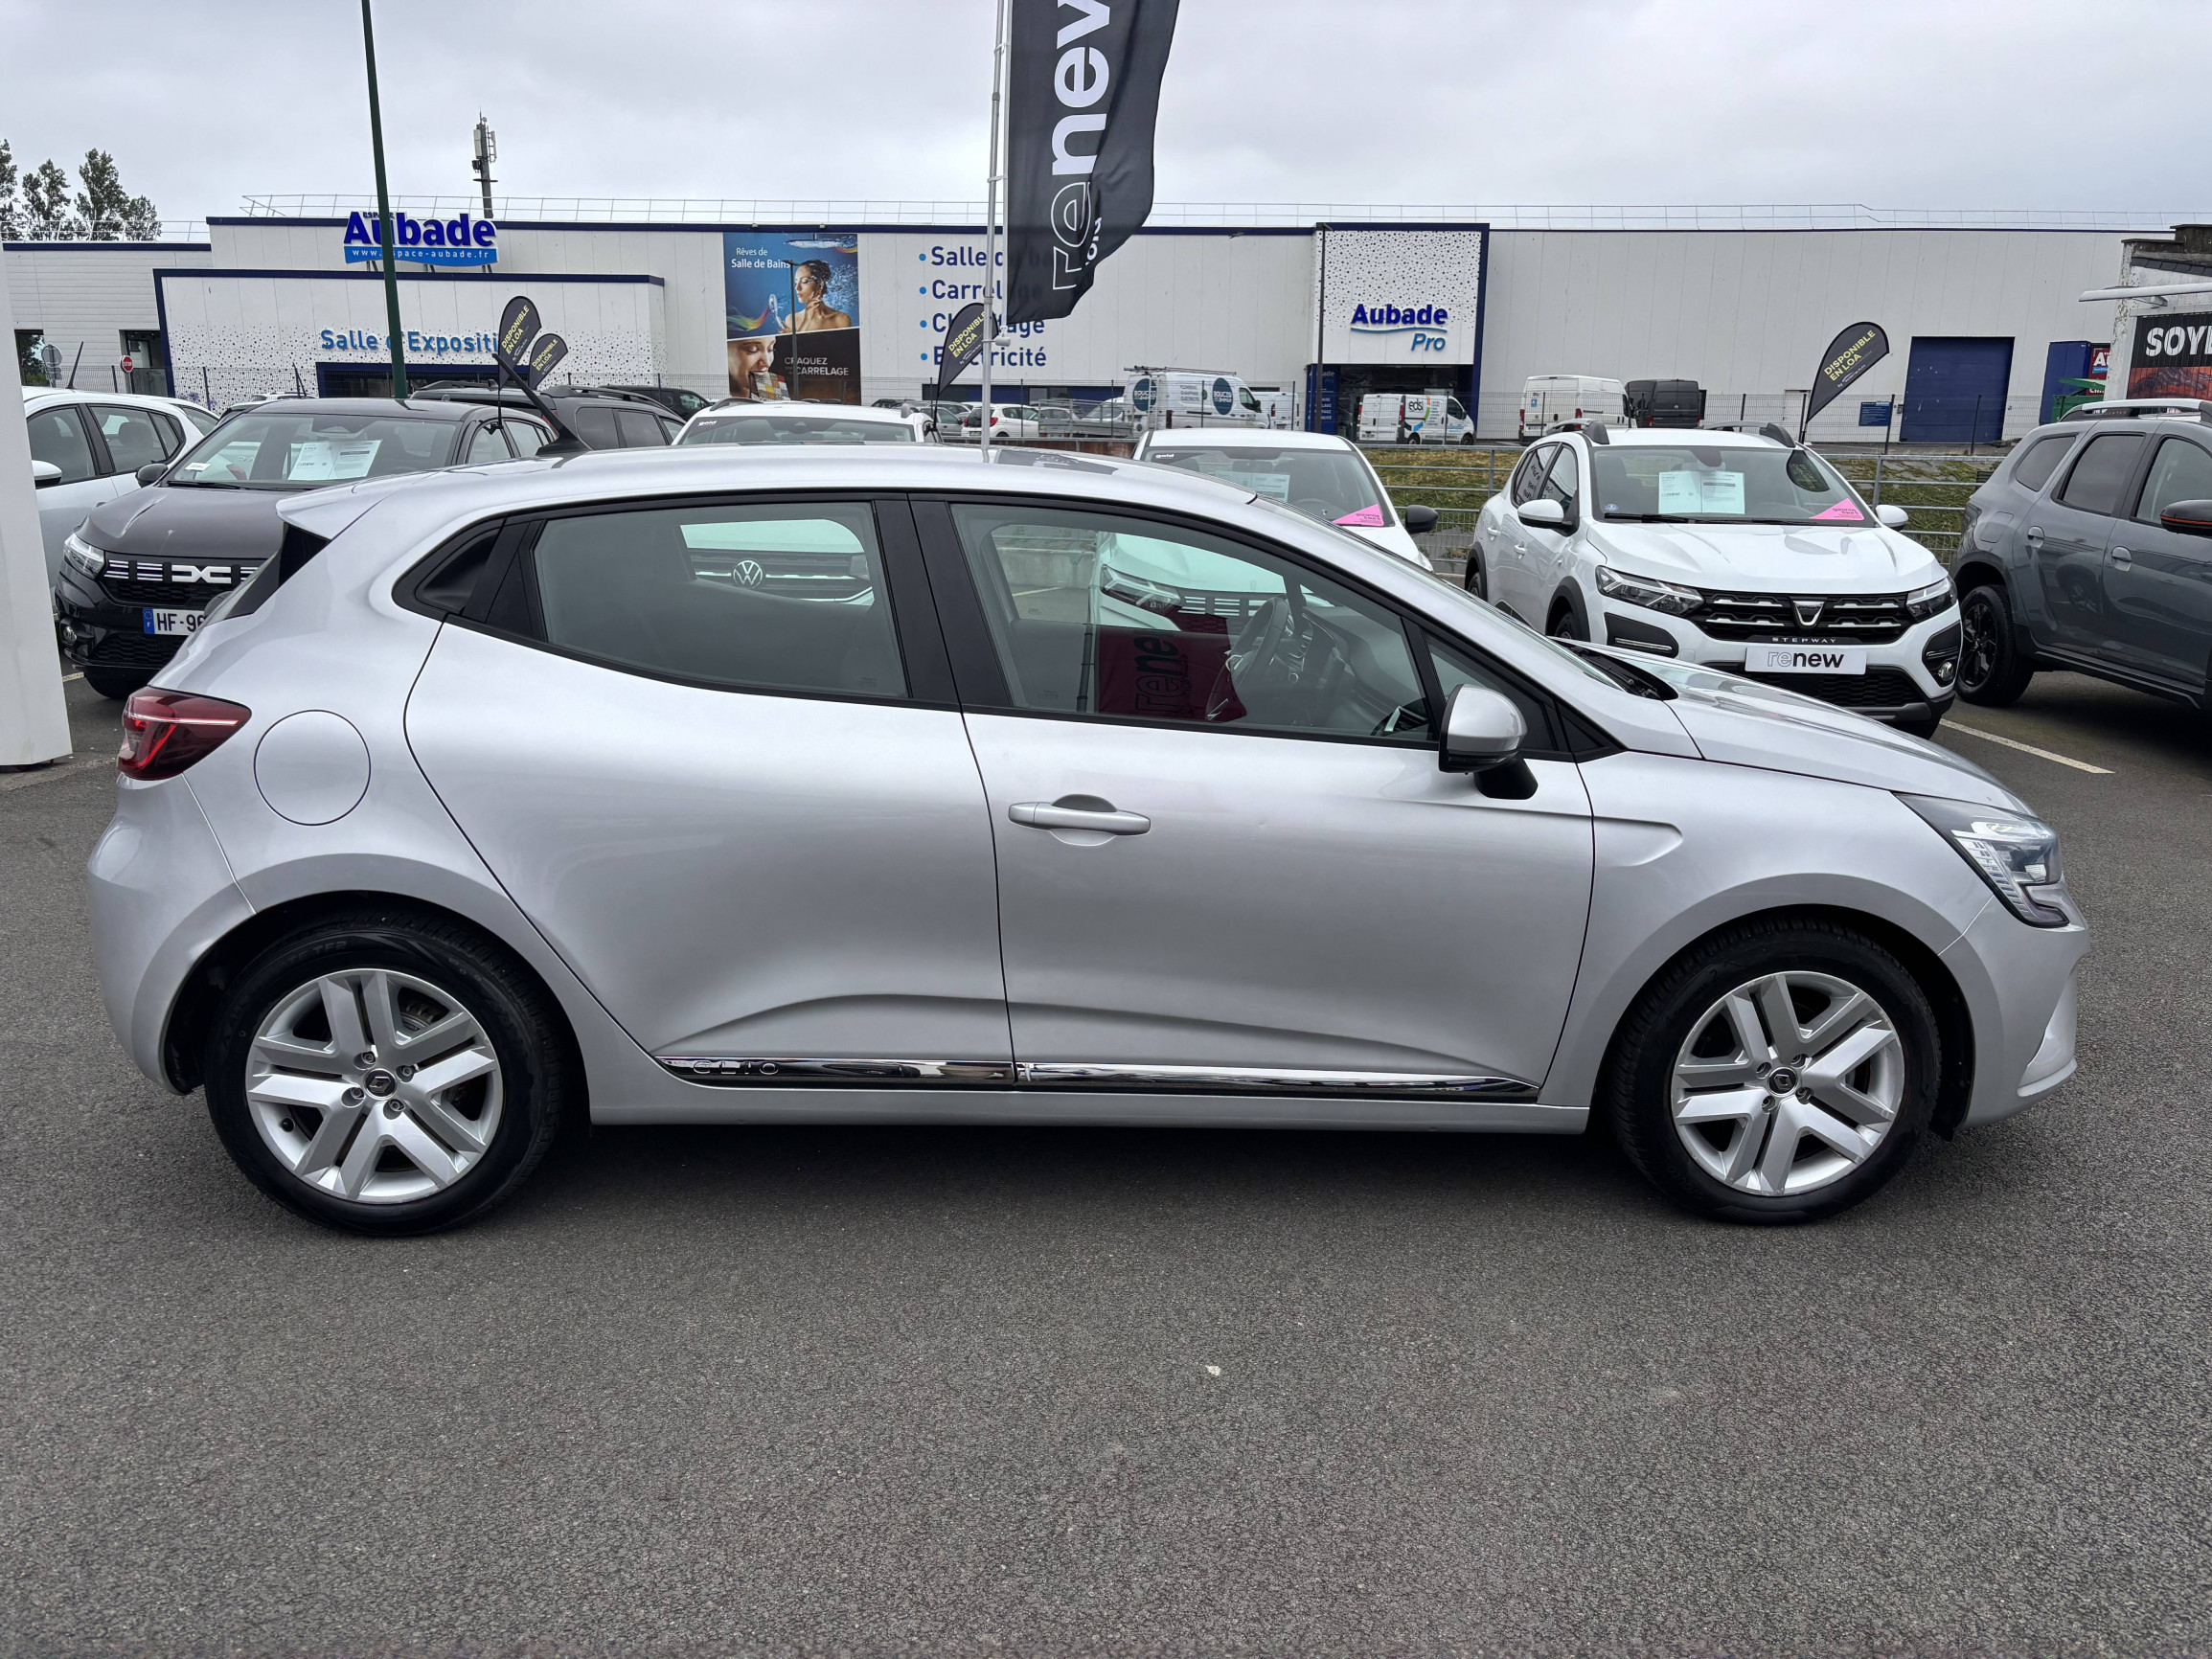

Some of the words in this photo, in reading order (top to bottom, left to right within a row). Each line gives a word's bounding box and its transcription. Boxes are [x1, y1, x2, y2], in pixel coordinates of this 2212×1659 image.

[343, 212, 496, 246] Aubade
[352, 249, 490, 259] www.pace-aubade.fr
[736, 247, 757, 256] Rêves
[758, 246, 768, 256] de
[931, 246, 987, 267] Salle
[731, 259, 753, 268] Salle
[754, 259, 765, 268] de
[767, 259, 790, 269] Bains
[1351, 304, 1448, 325] Aubade
[501, 305, 530, 349] DISPONIBLE
[320, 330, 378, 351] Salle
[505, 343, 515, 354] EN
[512, 328, 524, 344] LOA
[952, 346, 964, 357] EN
[962, 333, 977, 349] LOA
[1410, 333, 1447, 352] Pro
[532, 338, 559, 367] DISPONIBLE
[1823, 330, 1876, 375] DISPONIBLE
[796, 366, 850, 375] CARRELAGE
[1830, 368, 1844, 381] EN
[1841, 353, 1861, 371] LOA
[1767, 651, 1845, 669] renew
[693, 1059, 780, 1076] CLIO
